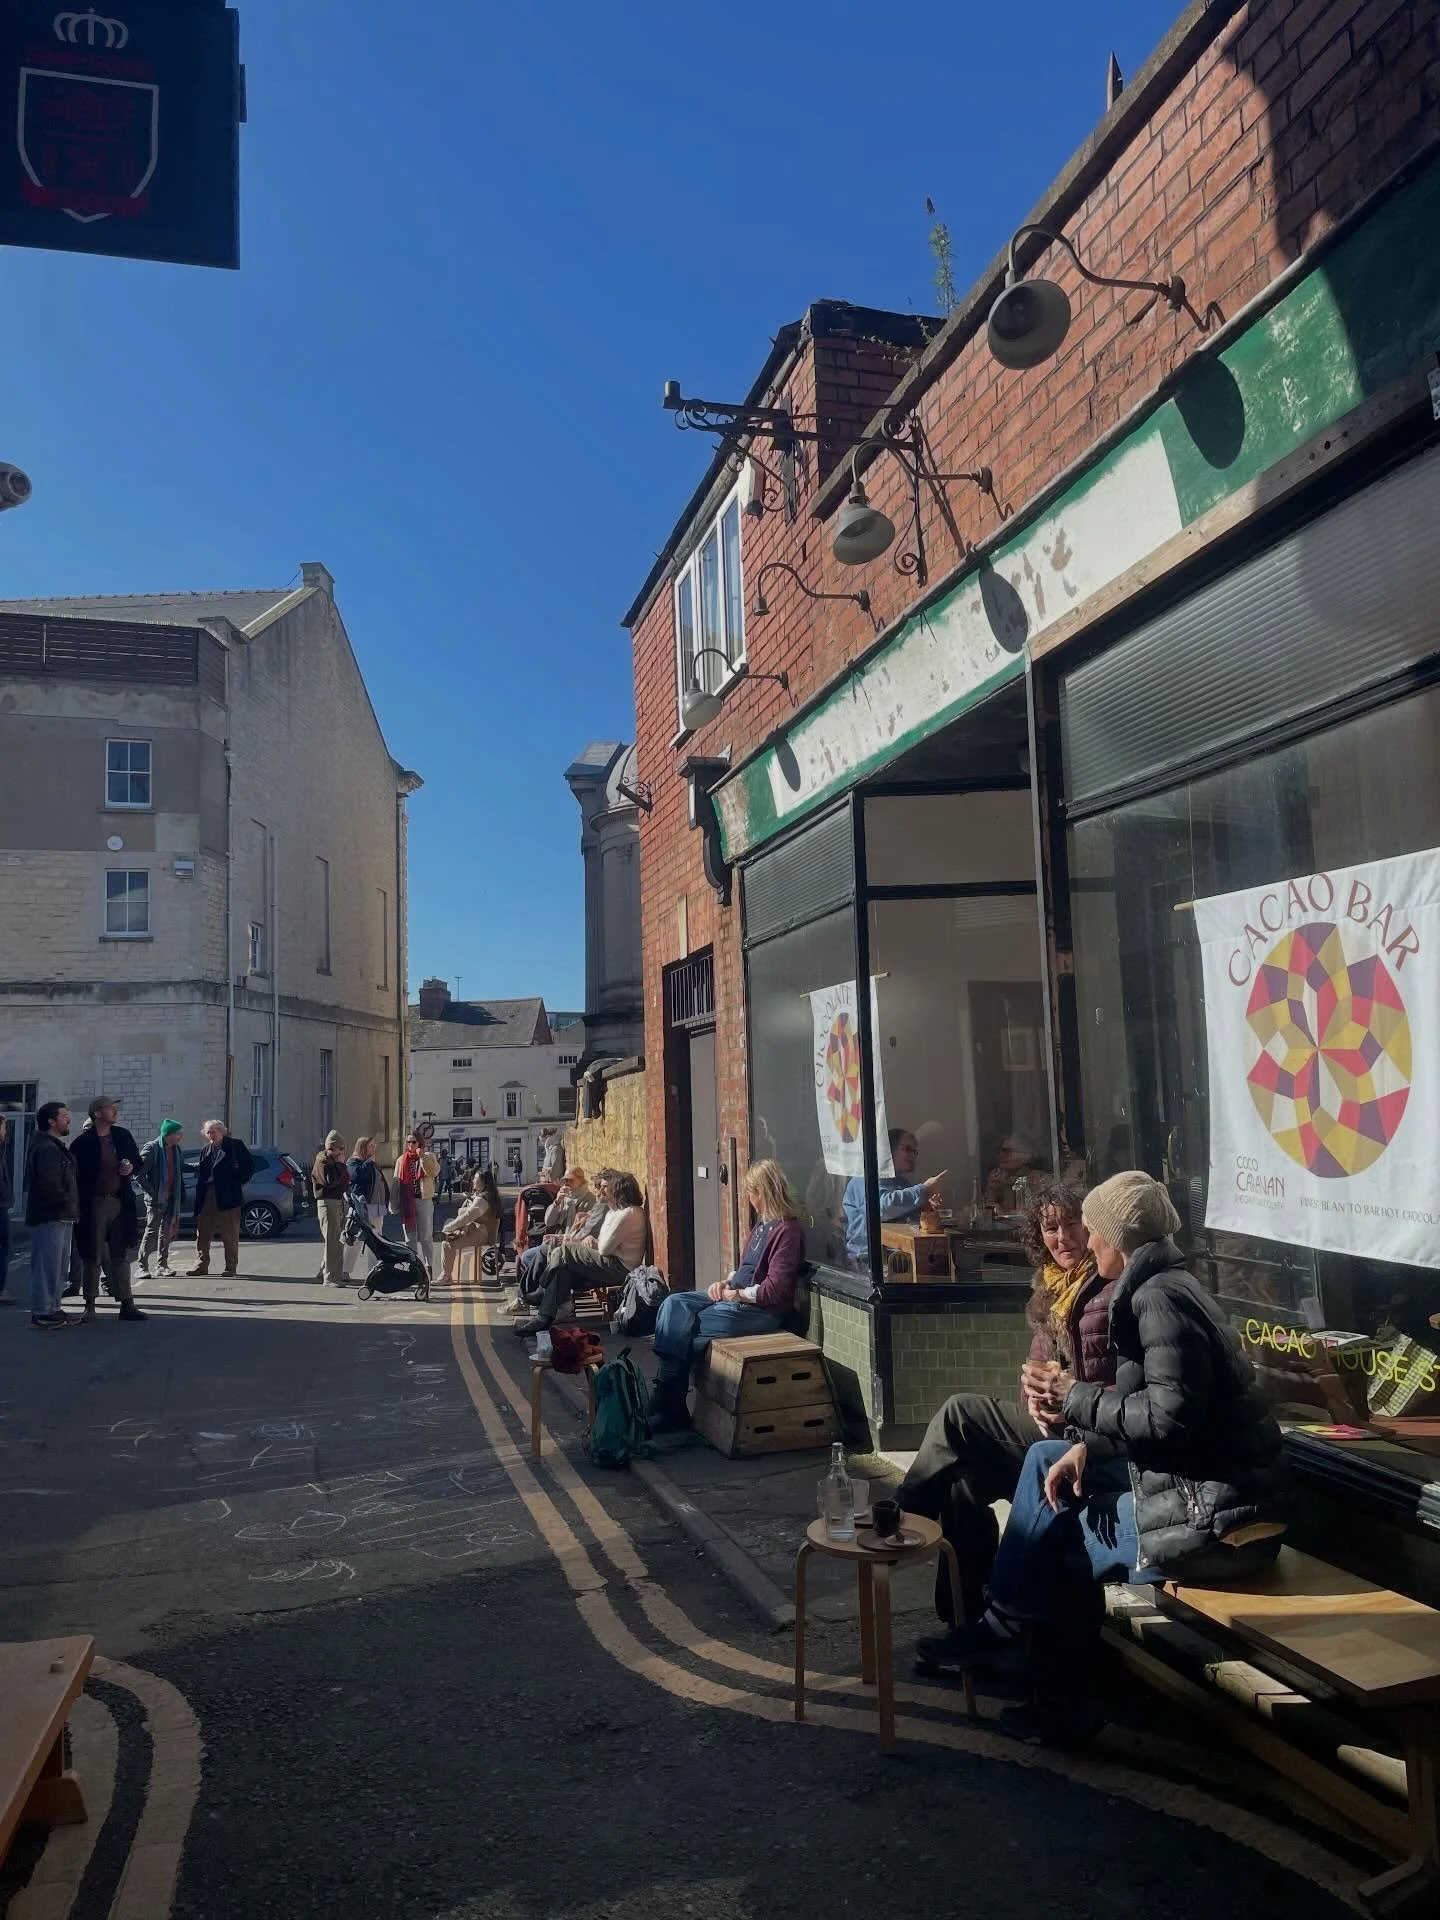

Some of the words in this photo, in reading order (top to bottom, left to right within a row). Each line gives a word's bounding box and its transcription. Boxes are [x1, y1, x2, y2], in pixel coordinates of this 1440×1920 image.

[1228, 873, 1334, 986] CACAO
[1346, 879, 1420, 971] BAR
[1236, 1155, 1259, 1172] COCO
[1236, 1171, 1285, 1198] CARAVAN
[1246, 1318, 1317, 1359] CACAO
